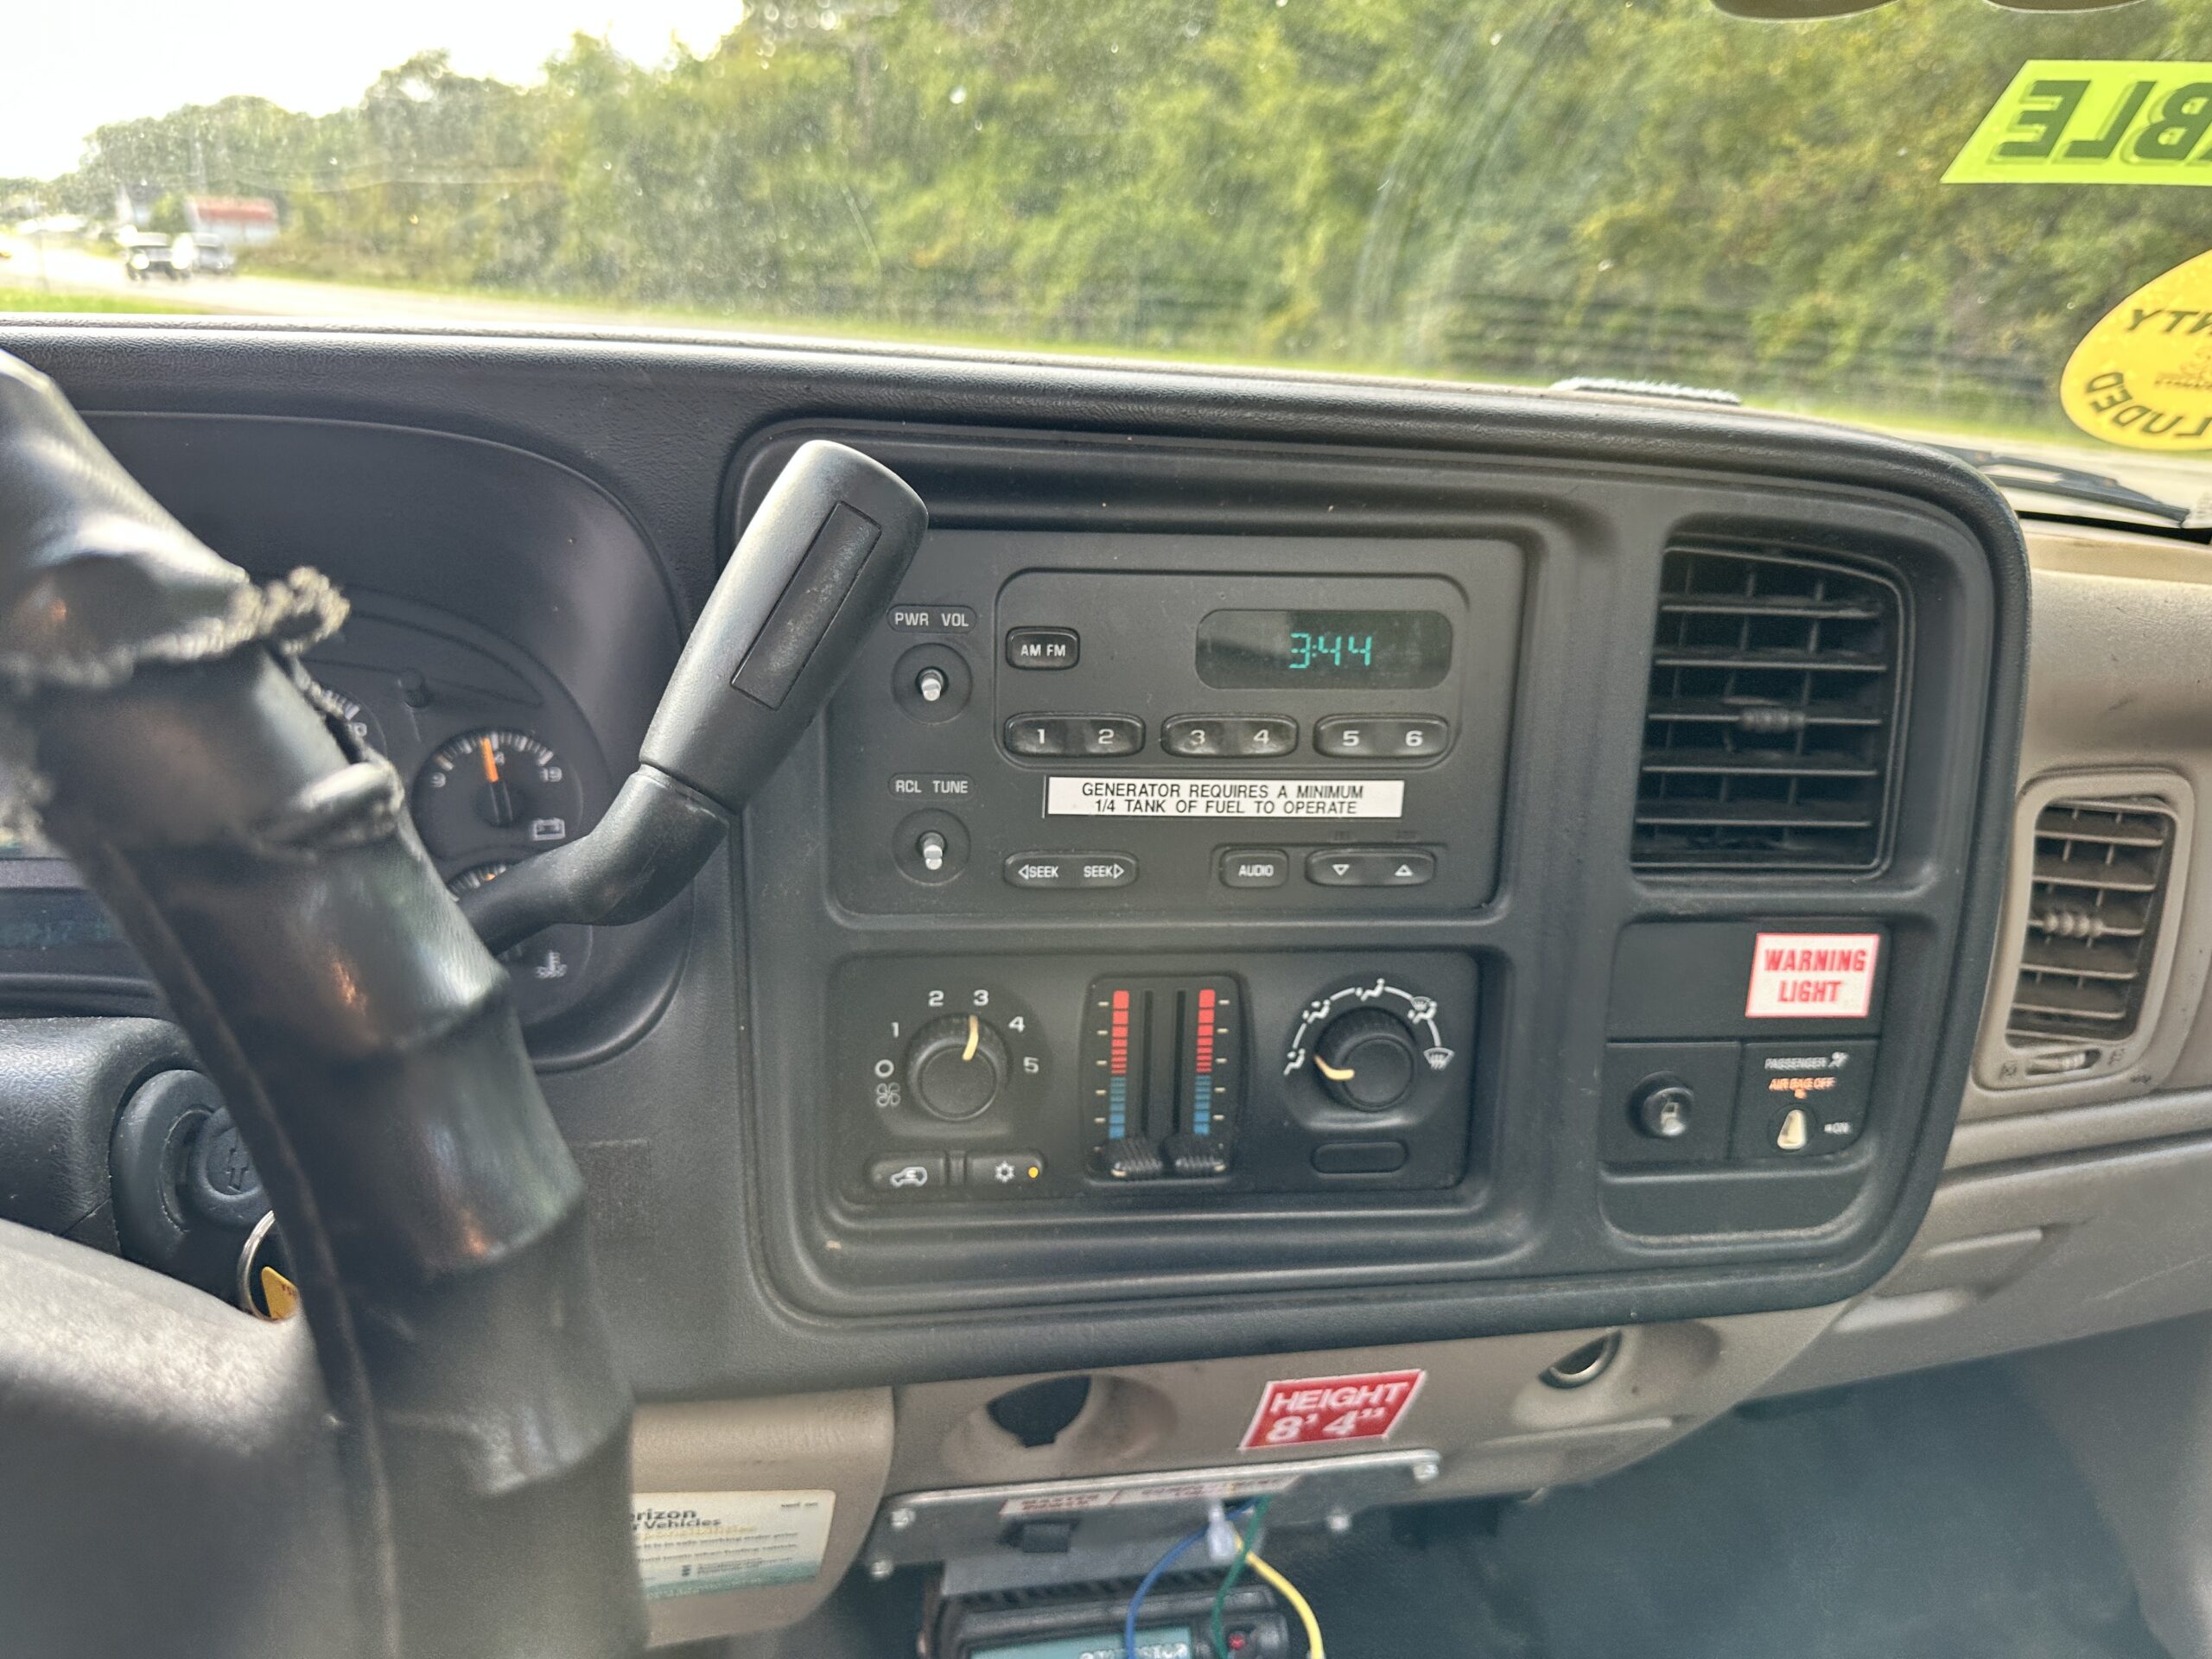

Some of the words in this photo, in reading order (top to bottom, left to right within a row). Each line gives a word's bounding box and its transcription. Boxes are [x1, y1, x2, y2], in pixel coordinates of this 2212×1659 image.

[895, 612, 929, 626] PWR
[941, 613, 969, 627] VOL
[1020, 644, 1041, 657] AM
[1046, 644, 1066, 657] FM
[1288, 632, 1372, 669] 3:44
[1036, 728, 1046, 745] 1
[1097, 728, 1115, 745] 2
[1188, 729, 1205, 745] 3
[1253, 729, 1270, 745] 4
[1342, 730, 1360, 747] 5
[1405, 730, 1423, 747] 6
[895, 779, 922, 794] RCL
[933, 780, 969, 794] TUNE
[1082, 782, 1180, 798] GENERATOR
[1189, 784, 1268, 799] REQUIRES
[1276, 785, 1288, 799] A
[1296, 785, 1364, 799] MINIMUM
[1096, 799, 1116, 812] 1/4
[1124, 799, 1166, 813] TANK
[1175, 800, 1198, 813] OF
[1205, 800, 1245, 814] FUEL
[1255, 800, 1275, 814] TO
[1283, 800, 1357, 815] OPERATE
[1029, 866, 1059, 879] SEEK
[1084, 866, 1113, 879] SEEK
[1238, 864, 1274, 877] AUDIO
[1764, 949, 1867, 972] WARNING
[928, 990, 944, 1007] 2
[973, 989, 989, 1007] 3
[1777, 980, 1843, 1002] LIGHT
[891, 1021, 899, 1038] 1
[1008, 1016, 1026, 1033] 4
[1023, 1056, 1039, 1073] 5
[1764, 1057, 1827, 1071] PASSENGER
[1769, 1077, 1789, 1091] AIR
[1789, 1077, 1813, 1090] BAG
[1814, 1077, 1837, 1090] OFF
[1831, 1122, 1851, 1135] ON
[1269, 1382, 1410, 1414] HEIGHT
[630, 1509, 697, 1522] rizon
[644, 1518, 721, 1529] Vehicles
